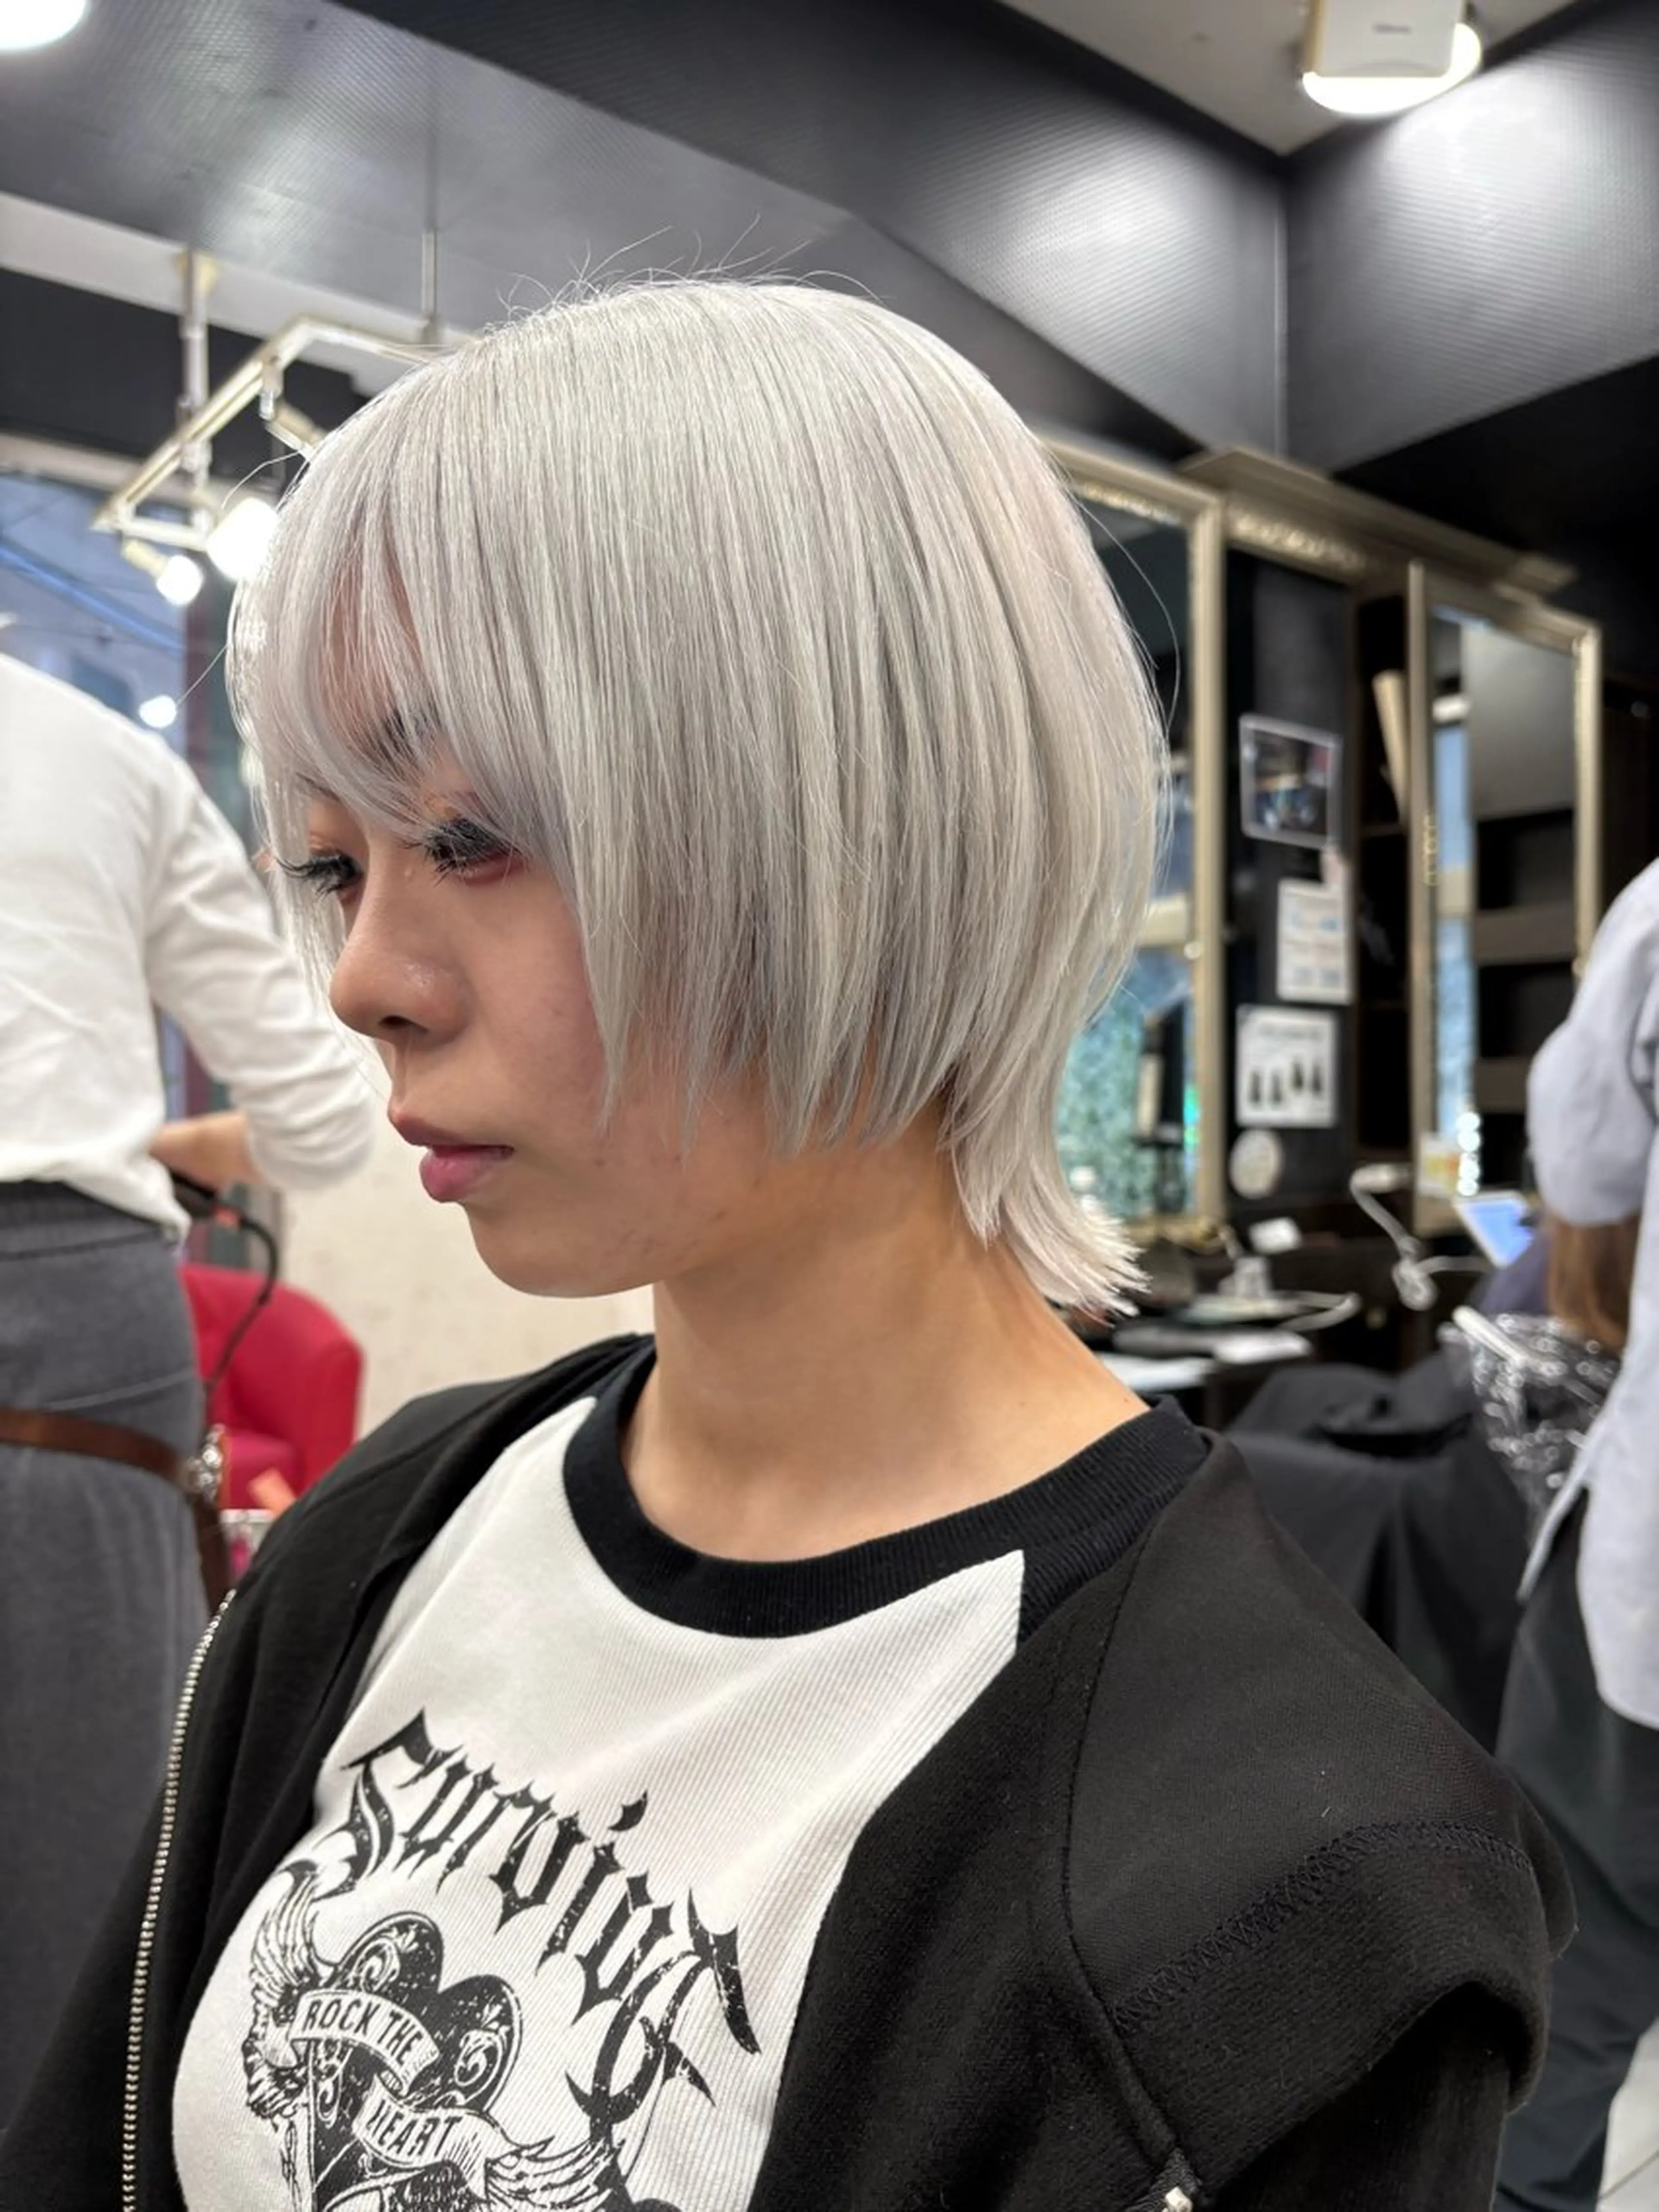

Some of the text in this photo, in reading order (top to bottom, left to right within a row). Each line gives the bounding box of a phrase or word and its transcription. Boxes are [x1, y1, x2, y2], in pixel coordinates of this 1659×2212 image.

[303, 1999, 423, 2066] ROCK THE
[366, 2099, 462, 2158] HEART
